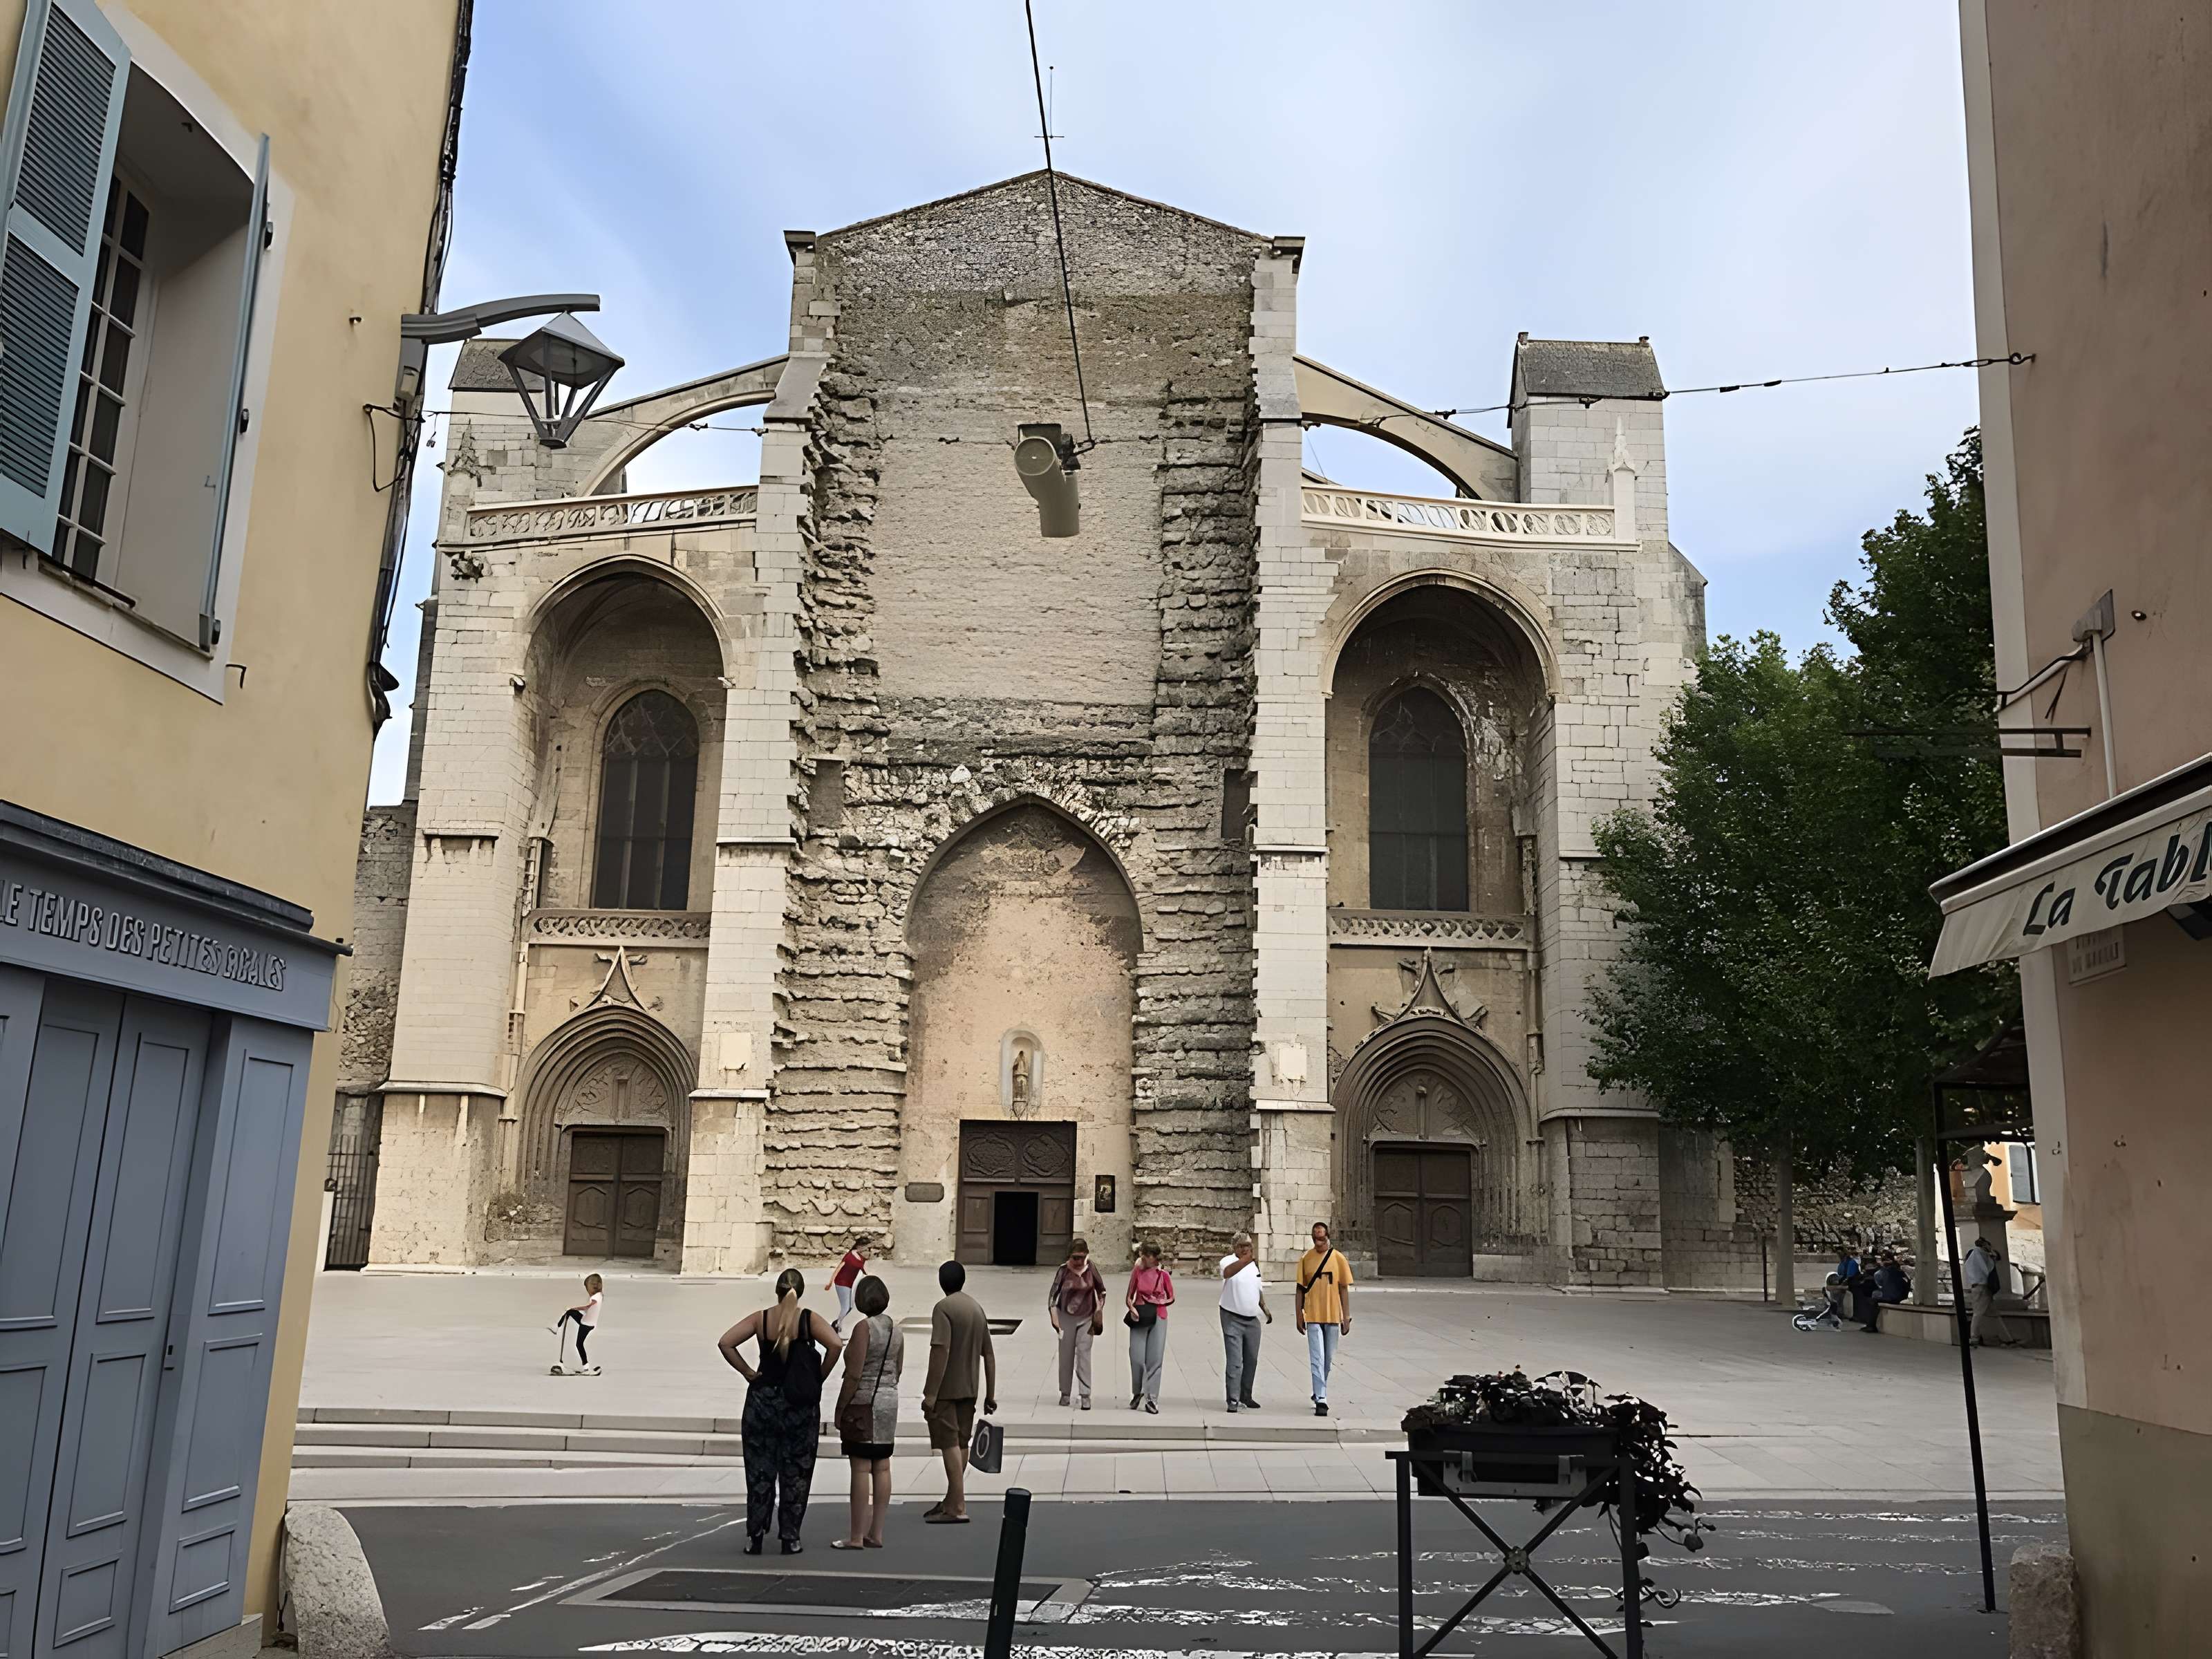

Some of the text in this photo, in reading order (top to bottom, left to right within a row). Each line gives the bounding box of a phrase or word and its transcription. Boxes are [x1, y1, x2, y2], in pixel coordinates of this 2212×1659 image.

[28, 888, 103, 946] TEMPS
[105, 912, 145, 957] DES
[2023, 821, 2212, 936] La Tabl
